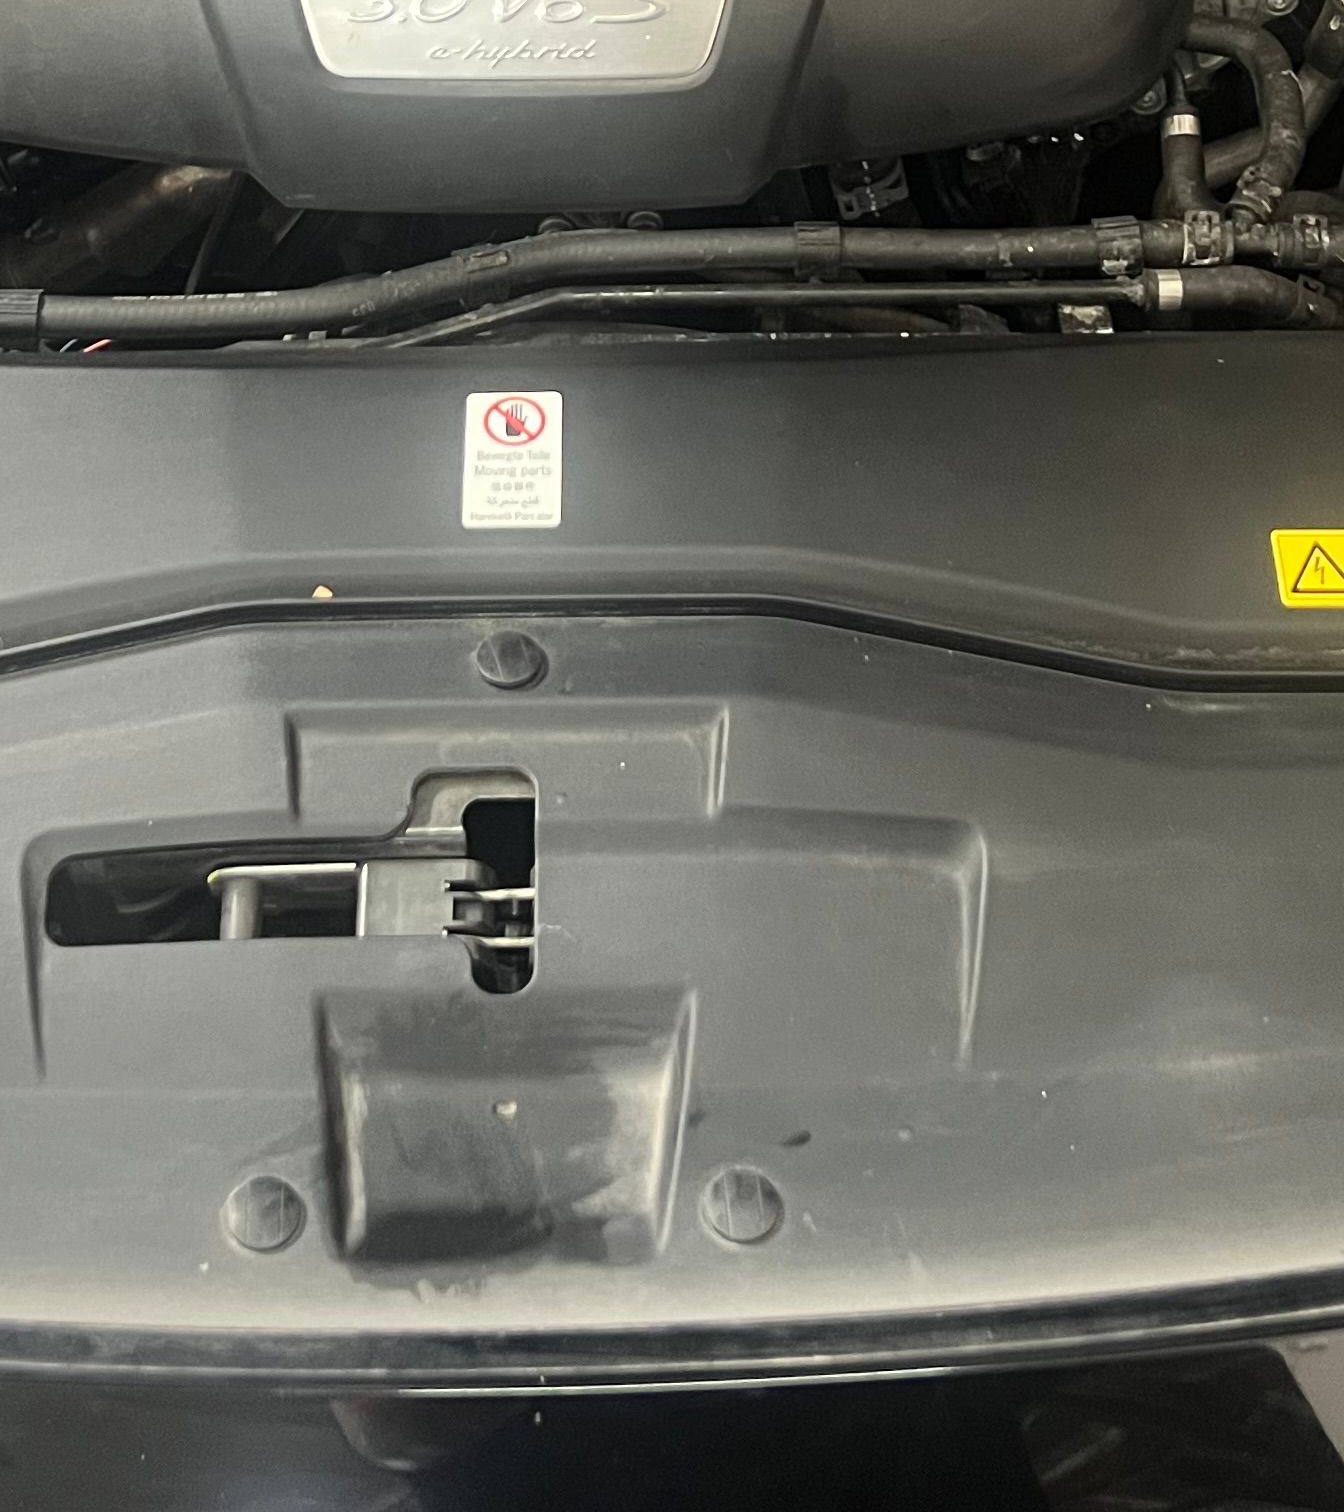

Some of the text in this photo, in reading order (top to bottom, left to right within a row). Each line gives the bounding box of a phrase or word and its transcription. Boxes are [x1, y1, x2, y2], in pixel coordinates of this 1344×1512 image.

[427, 38, 598, 70] e-hybrid
[474, 464, 552, 478] Moving parts
